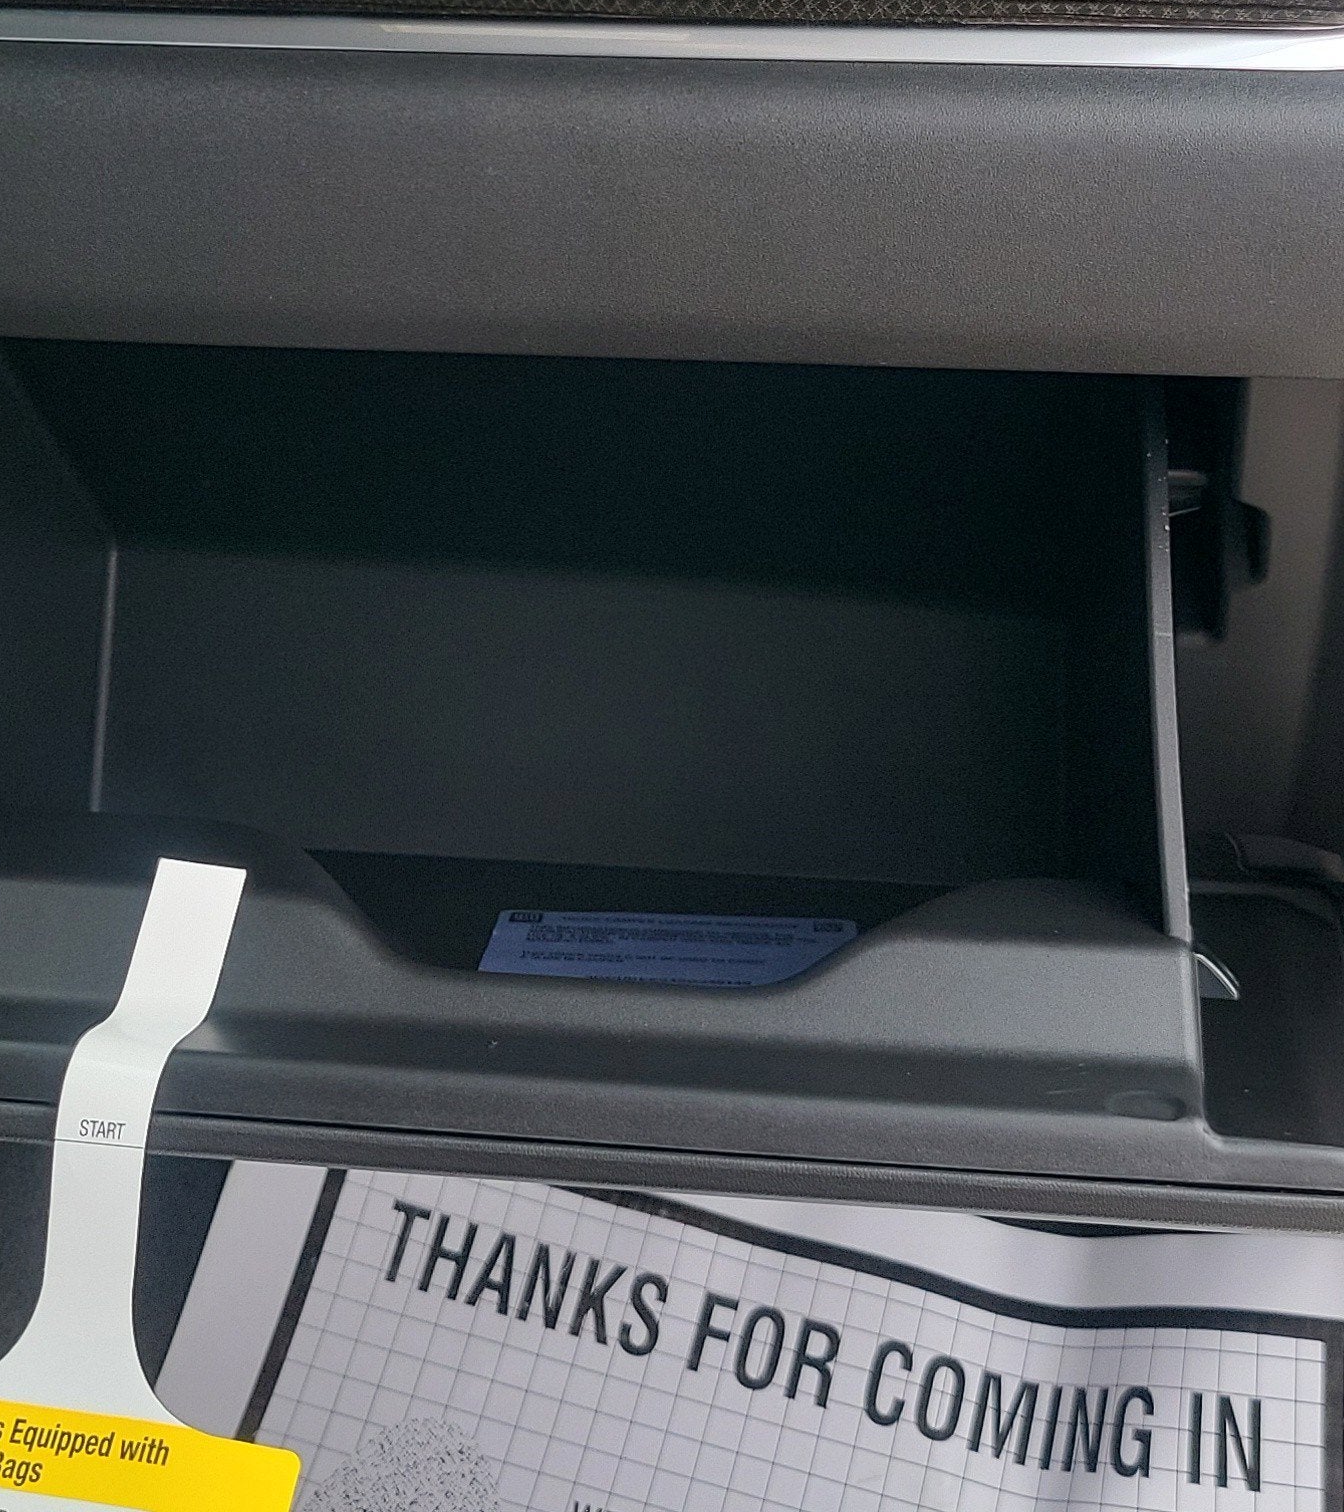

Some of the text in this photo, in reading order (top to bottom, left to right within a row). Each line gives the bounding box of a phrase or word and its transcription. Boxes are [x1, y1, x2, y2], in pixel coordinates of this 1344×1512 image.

[79, 1119, 126, 1140] START
[385, 1198, 1262, 1493] THANKS FOR COMING IN
[9, 1418, 116, 1458] Equipped
[120, 1436, 170, 1466] with
